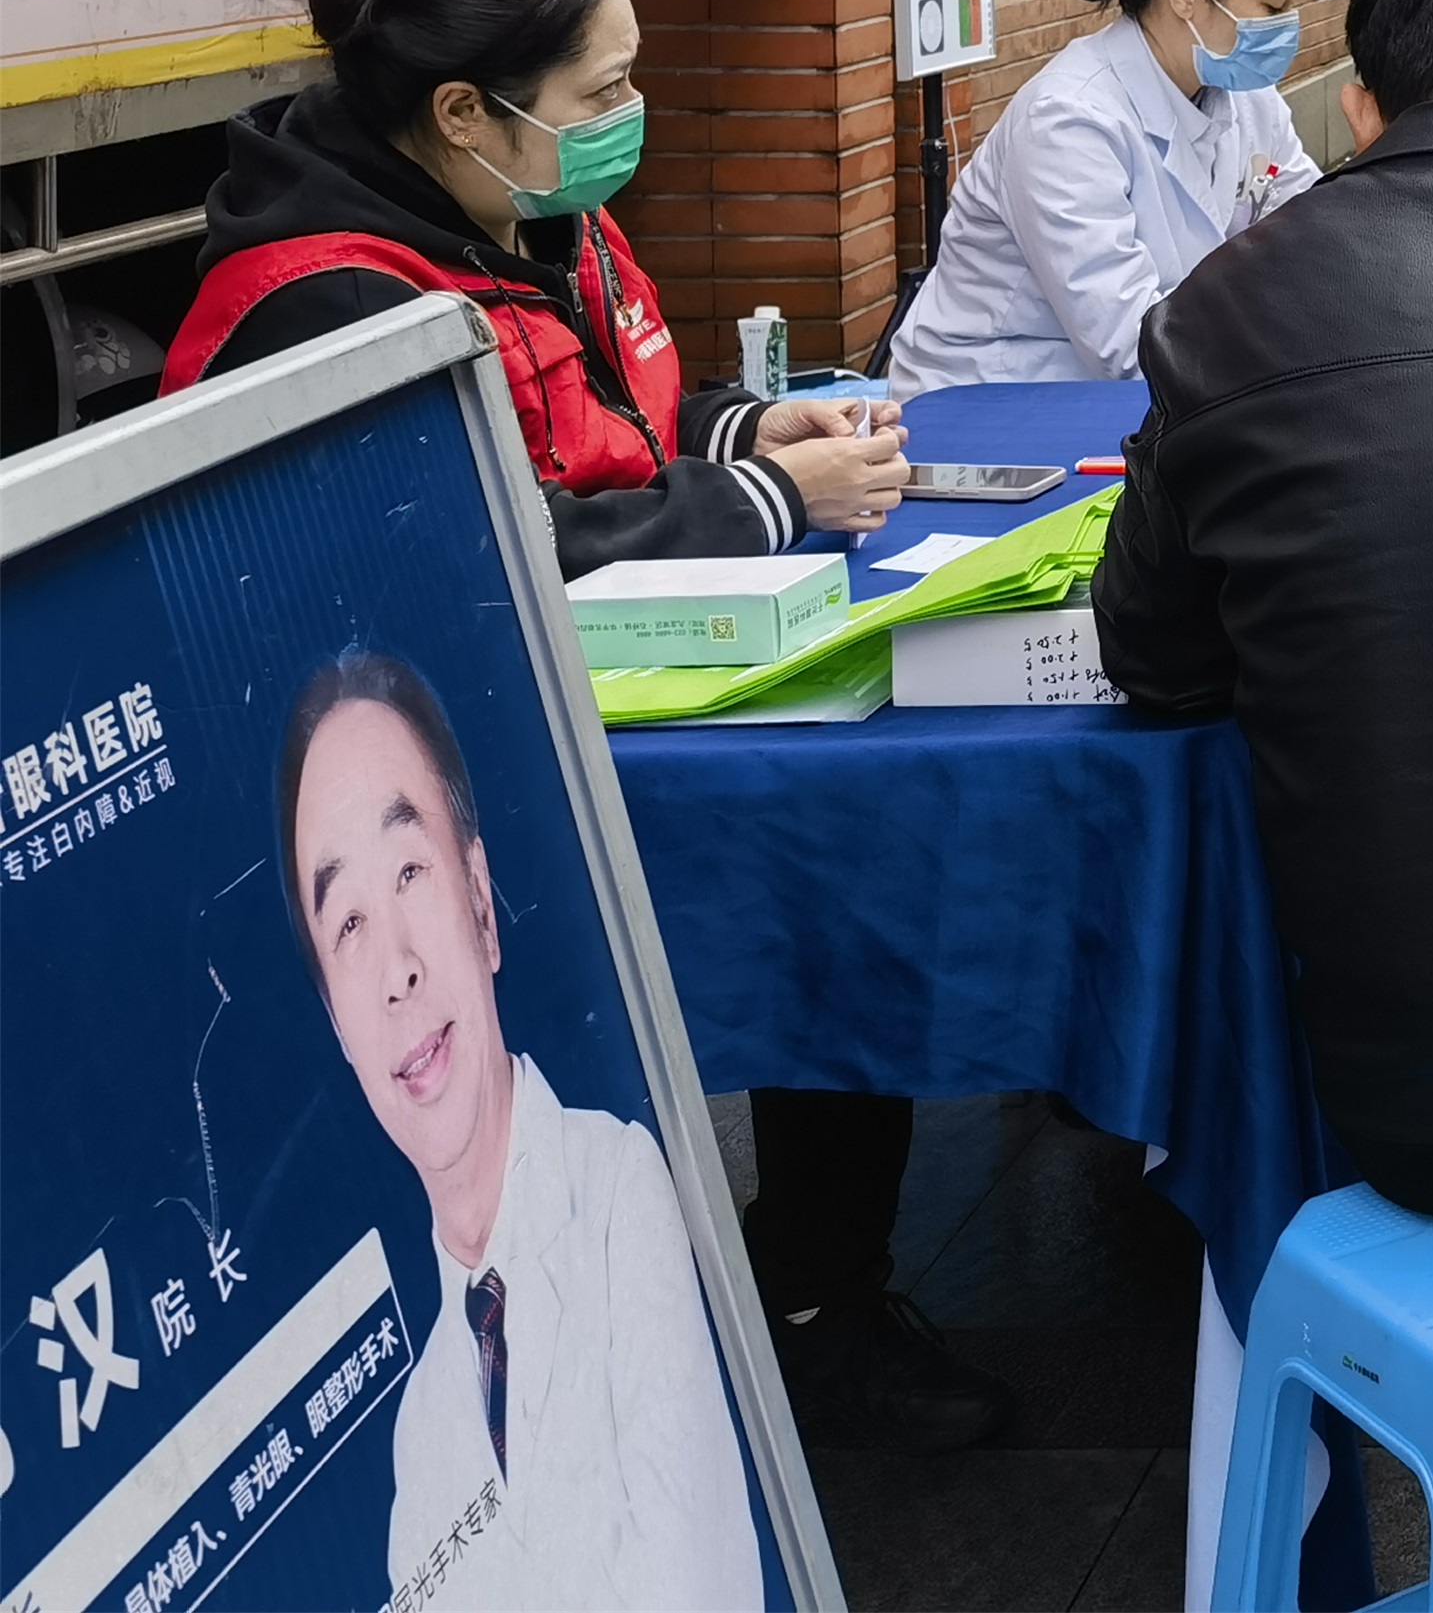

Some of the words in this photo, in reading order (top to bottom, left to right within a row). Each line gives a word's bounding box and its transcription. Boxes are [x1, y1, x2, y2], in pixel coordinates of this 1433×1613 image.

[2, 756, 177, 884] 专注白内障&近视
[151, 1228, 248, 1357] 院长
